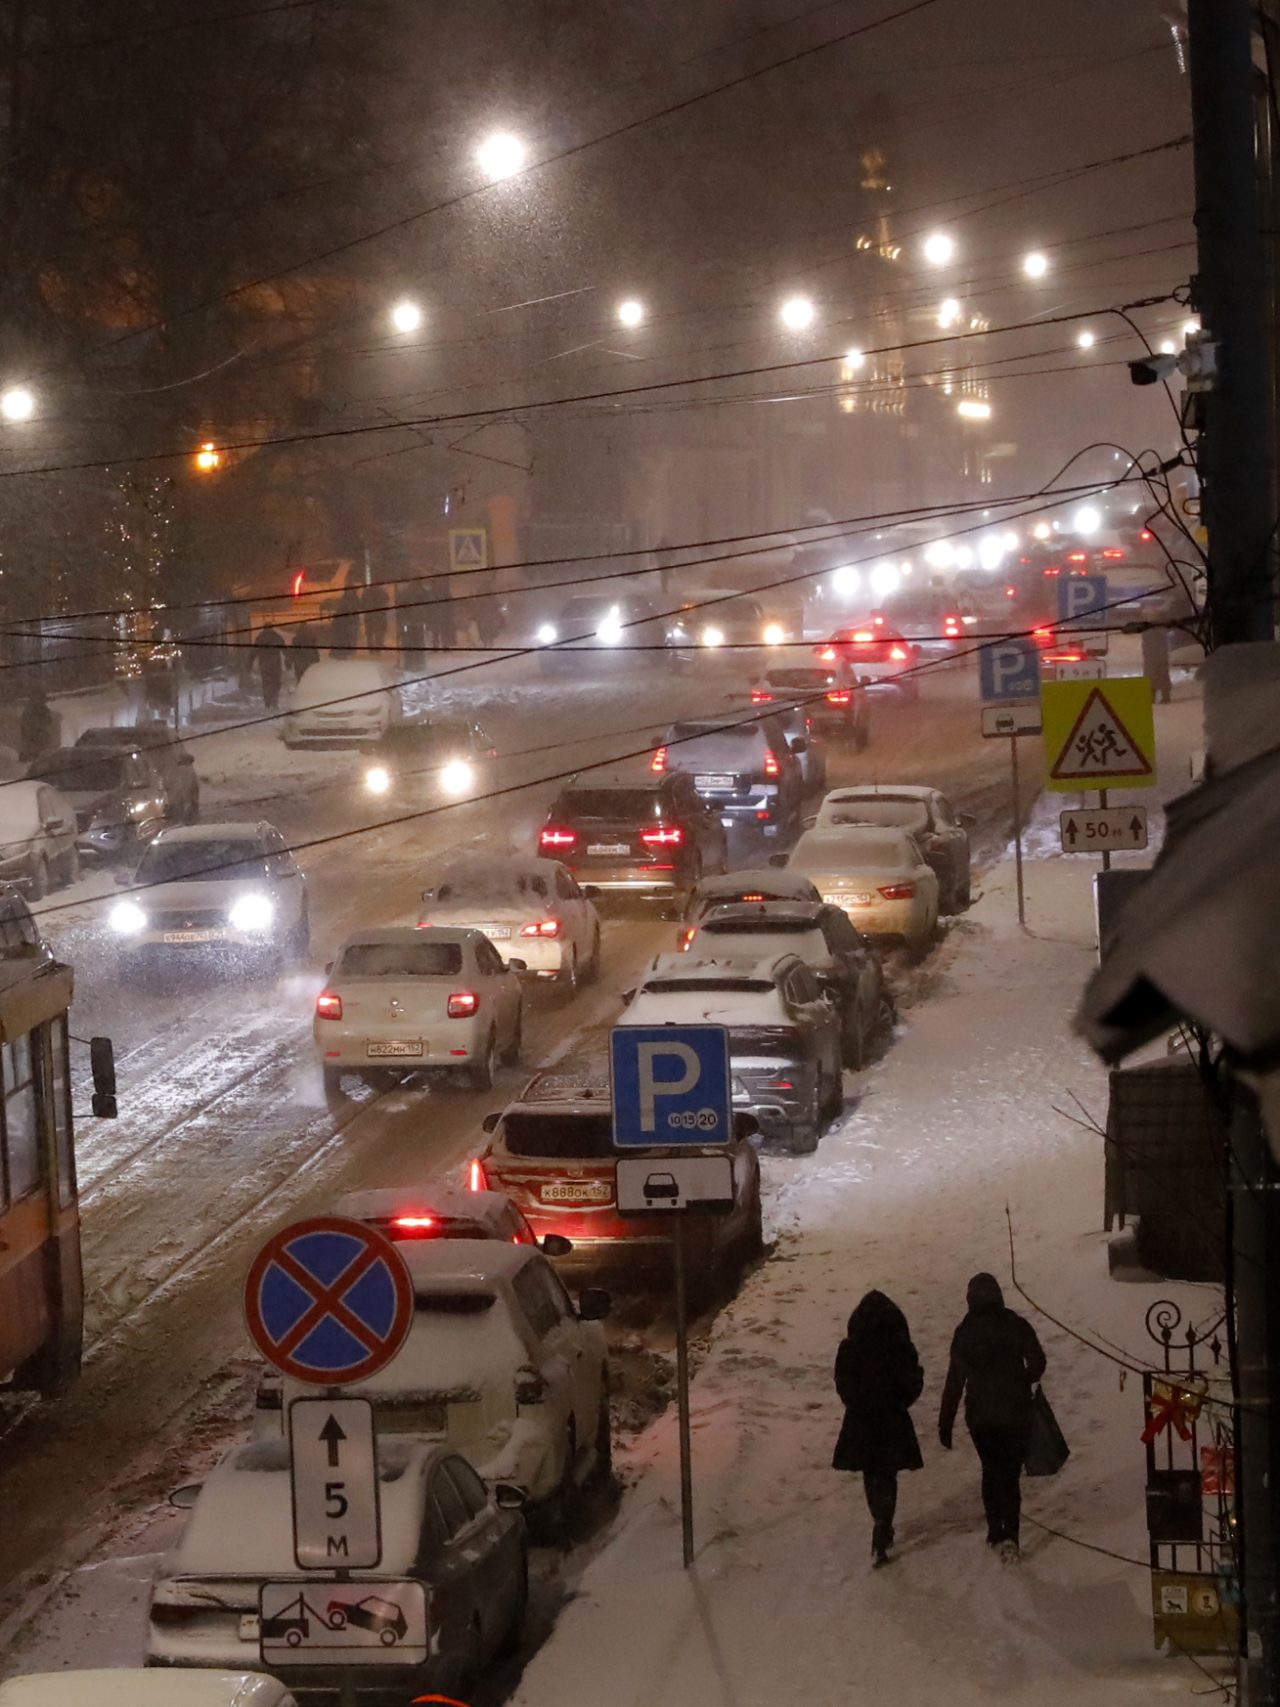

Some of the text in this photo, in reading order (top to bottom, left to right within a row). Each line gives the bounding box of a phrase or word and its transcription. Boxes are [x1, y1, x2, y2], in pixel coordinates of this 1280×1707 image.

[1067, 581, 1096, 618] P
[991, 646, 1025, 694] P
[1086, 821, 1109, 839] 50
[638, 1041, 701, 1132] P
[544, 1186, 608, 1198] К888ОК 152
[324, 1482, 349, 1519] 5
